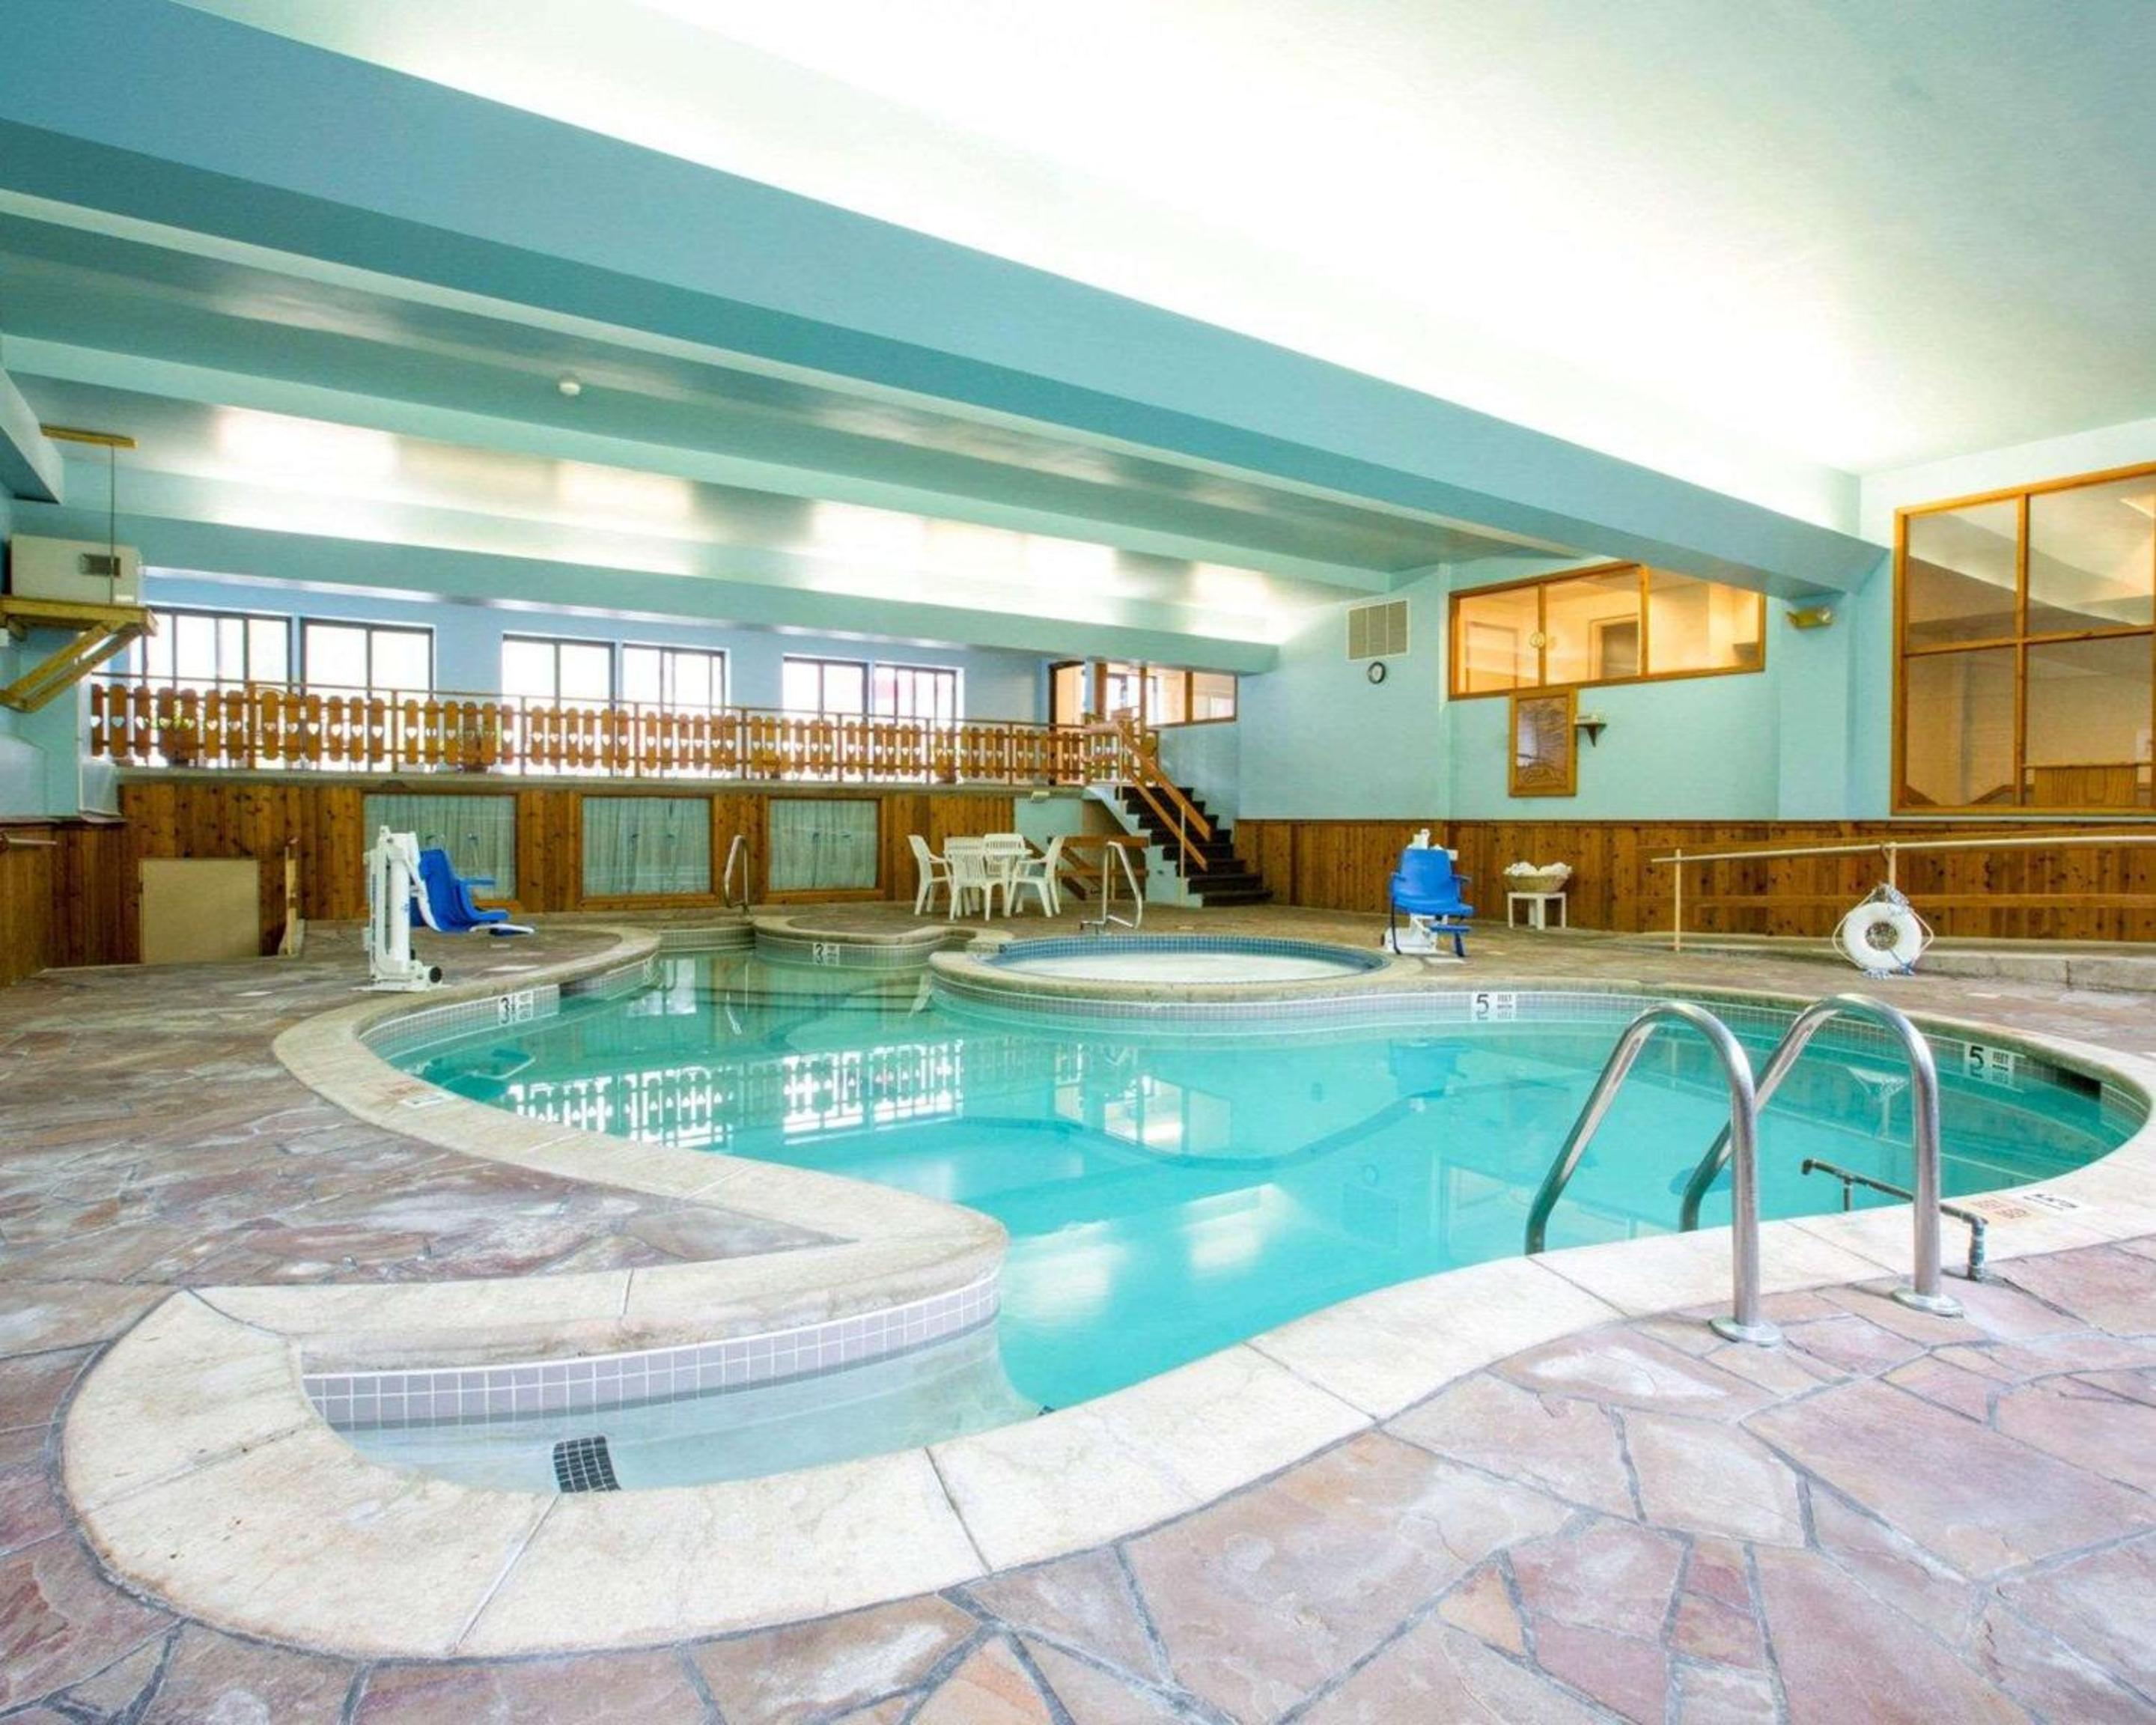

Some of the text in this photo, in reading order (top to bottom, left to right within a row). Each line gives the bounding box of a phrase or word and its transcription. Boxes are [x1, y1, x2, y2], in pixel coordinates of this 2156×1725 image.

[500, 997, 509, 1023] 3
[1476, 993, 1489, 1017] 5
[1970, 1045, 1984, 1074] 5
